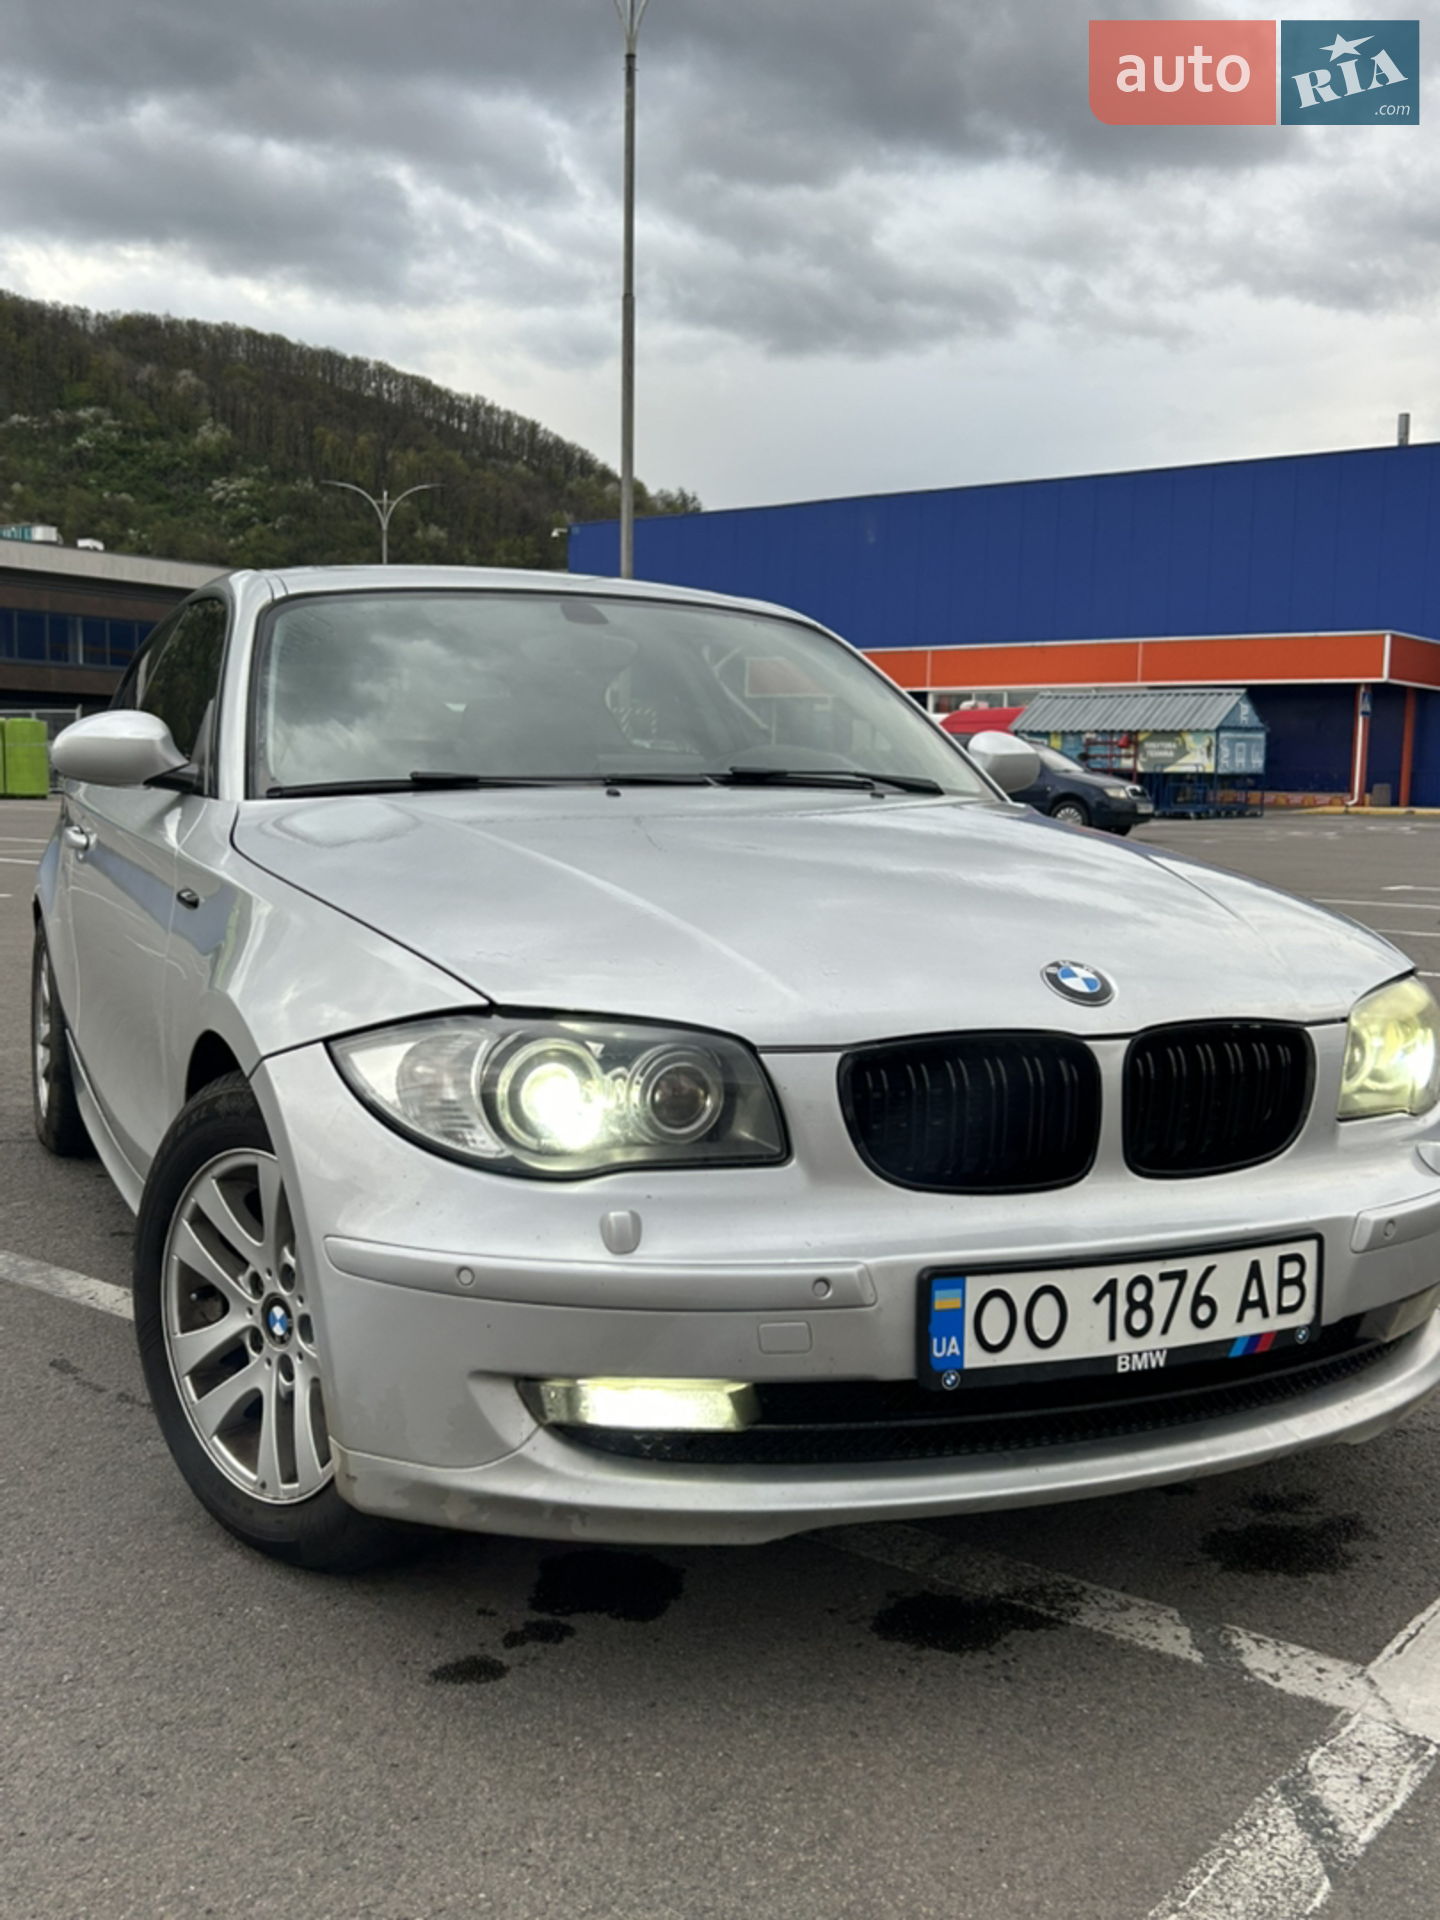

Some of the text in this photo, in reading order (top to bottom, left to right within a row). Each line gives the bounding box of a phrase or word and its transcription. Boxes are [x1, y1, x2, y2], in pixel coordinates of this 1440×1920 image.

[973, 1252, 1307, 1354] OO 1876 AB
[932, 1336, 961, 1358] UA
[1116, 1349, 1168, 1373] BMW
